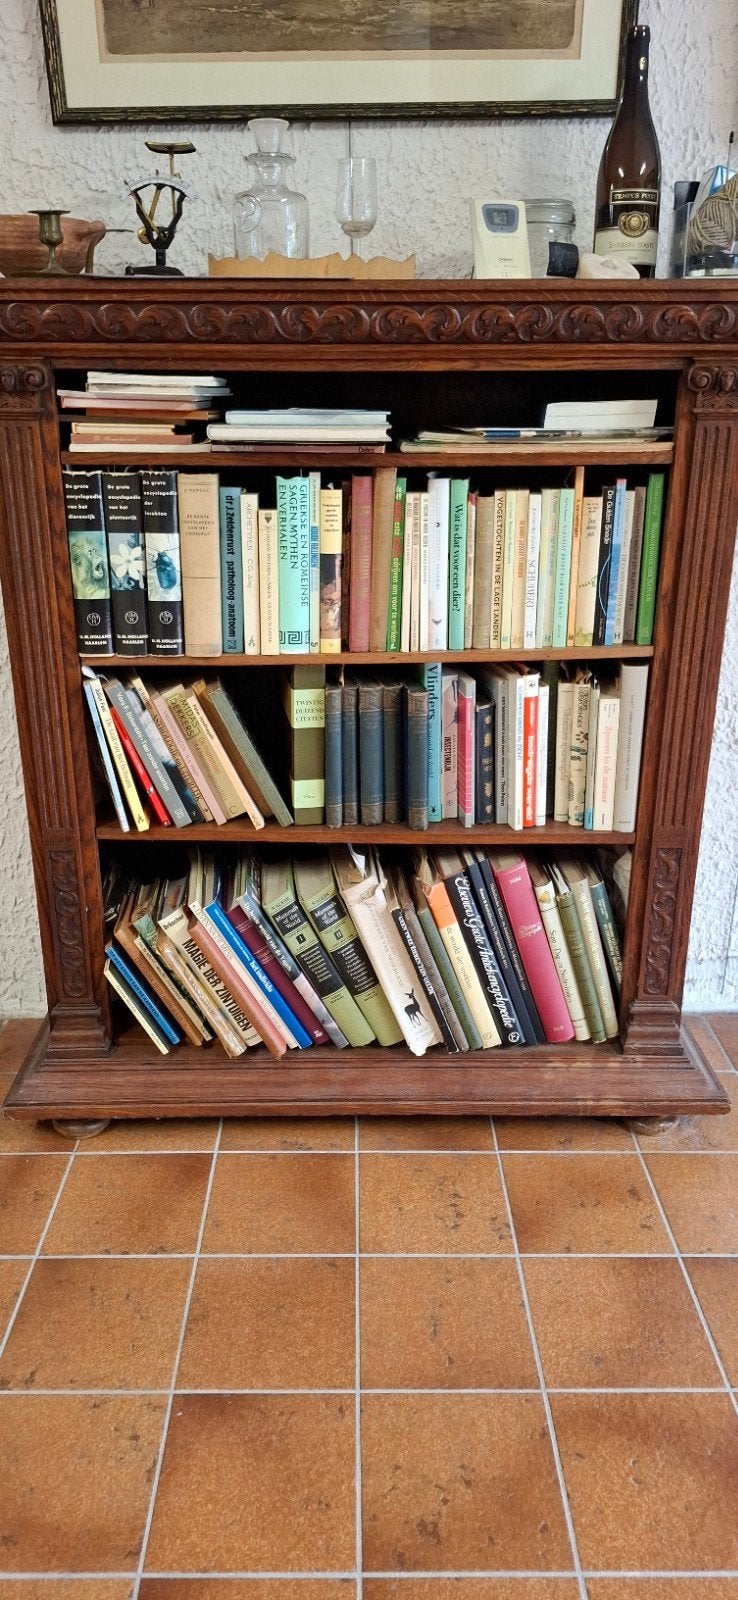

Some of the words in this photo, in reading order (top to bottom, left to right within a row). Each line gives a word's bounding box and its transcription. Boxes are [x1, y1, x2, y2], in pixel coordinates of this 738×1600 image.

[278, 484, 286, 499] EN
[606, 489, 614, 499] De
[300, 484, 308, 529] GRIEKSE
[453, 503, 463, 522] Wat
[604, 501, 613, 522] Gulden
[278, 502, 287, 560] VERHALEN
[300, 533, 308, 548] EN
[453, 523, 462, 531] is
[453, 532, 462, 548] dat
[494, 496, 503, 561] VOGELTOCHTEN
[289, 524, 297, 569] MYTHEN
[452, 549, 460, 570] voor
[300, 552, 308, 607] ROMEINSE
[493, 574, 500, 584] DE
[494, 563, 501, 571] IN
[525, 559, 536, 609] SCHUBERT
[451, 589, 461, 611] dier?
[427, 664, 438, 719] Vlinders
[170, 697, 193, 736] DEKKERS
[180, 699, 198, 727] MIDAS
[454, 877, 477, 916] Elseviers
[463, 915, 487, 944] Grote
[180, 937, 207, 970] MAGIE
[202, 966, 219, 988] DER
[216, 985, 251, 1032] ZINTUIGEN
